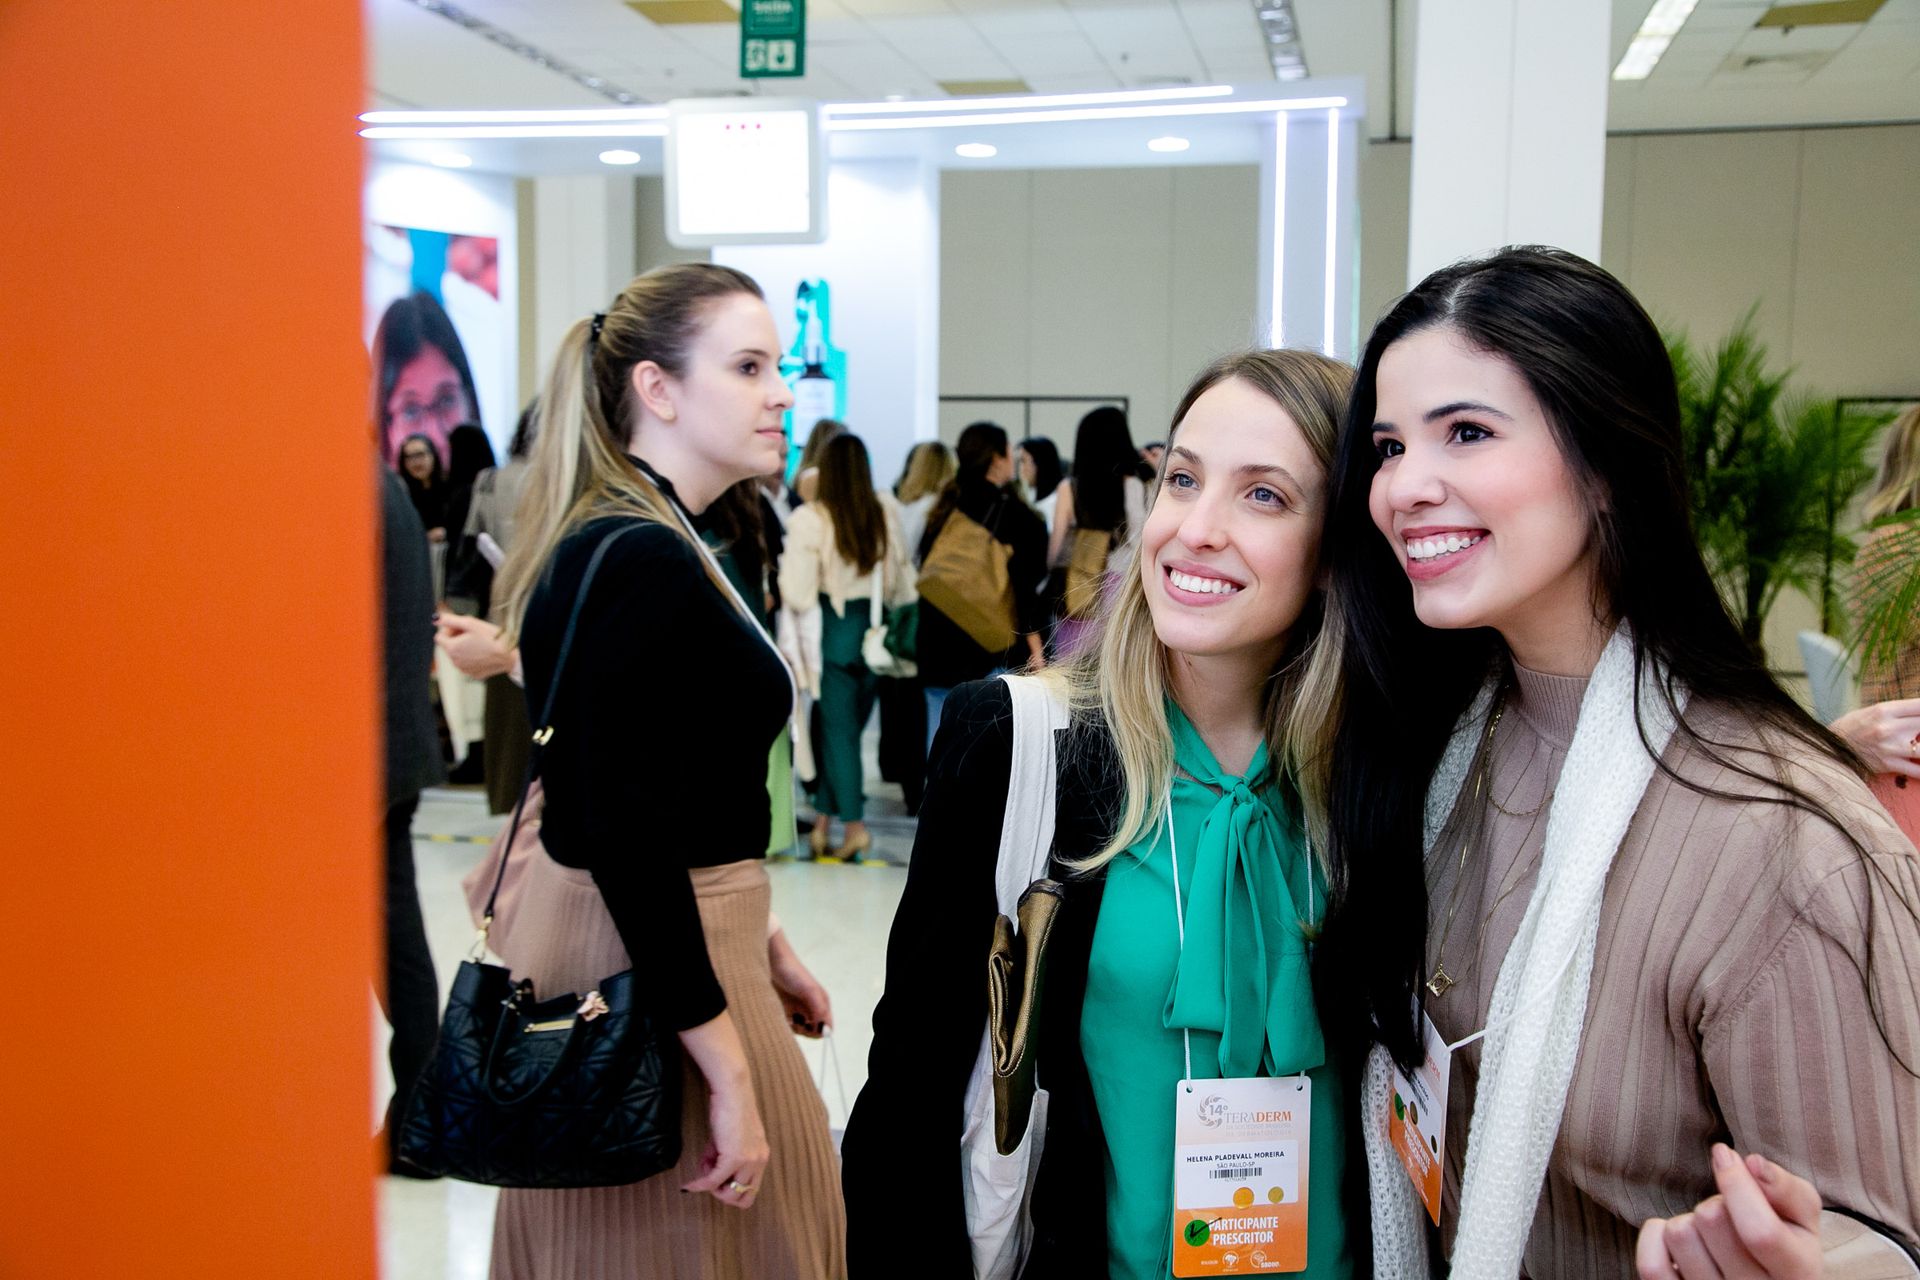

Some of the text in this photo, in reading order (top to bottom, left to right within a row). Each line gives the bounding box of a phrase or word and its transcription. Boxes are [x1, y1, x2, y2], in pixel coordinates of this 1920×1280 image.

[1224, 1111, 1292, 1123] TERADERM
[1186, 1151, 1285, 1163] HELENA PLADEVALL MOREIRA
[1208, 1216, 1279, 1231] PARTICIPANTE
[1212, 1231, 1274, 1246] PRESCRITOR
